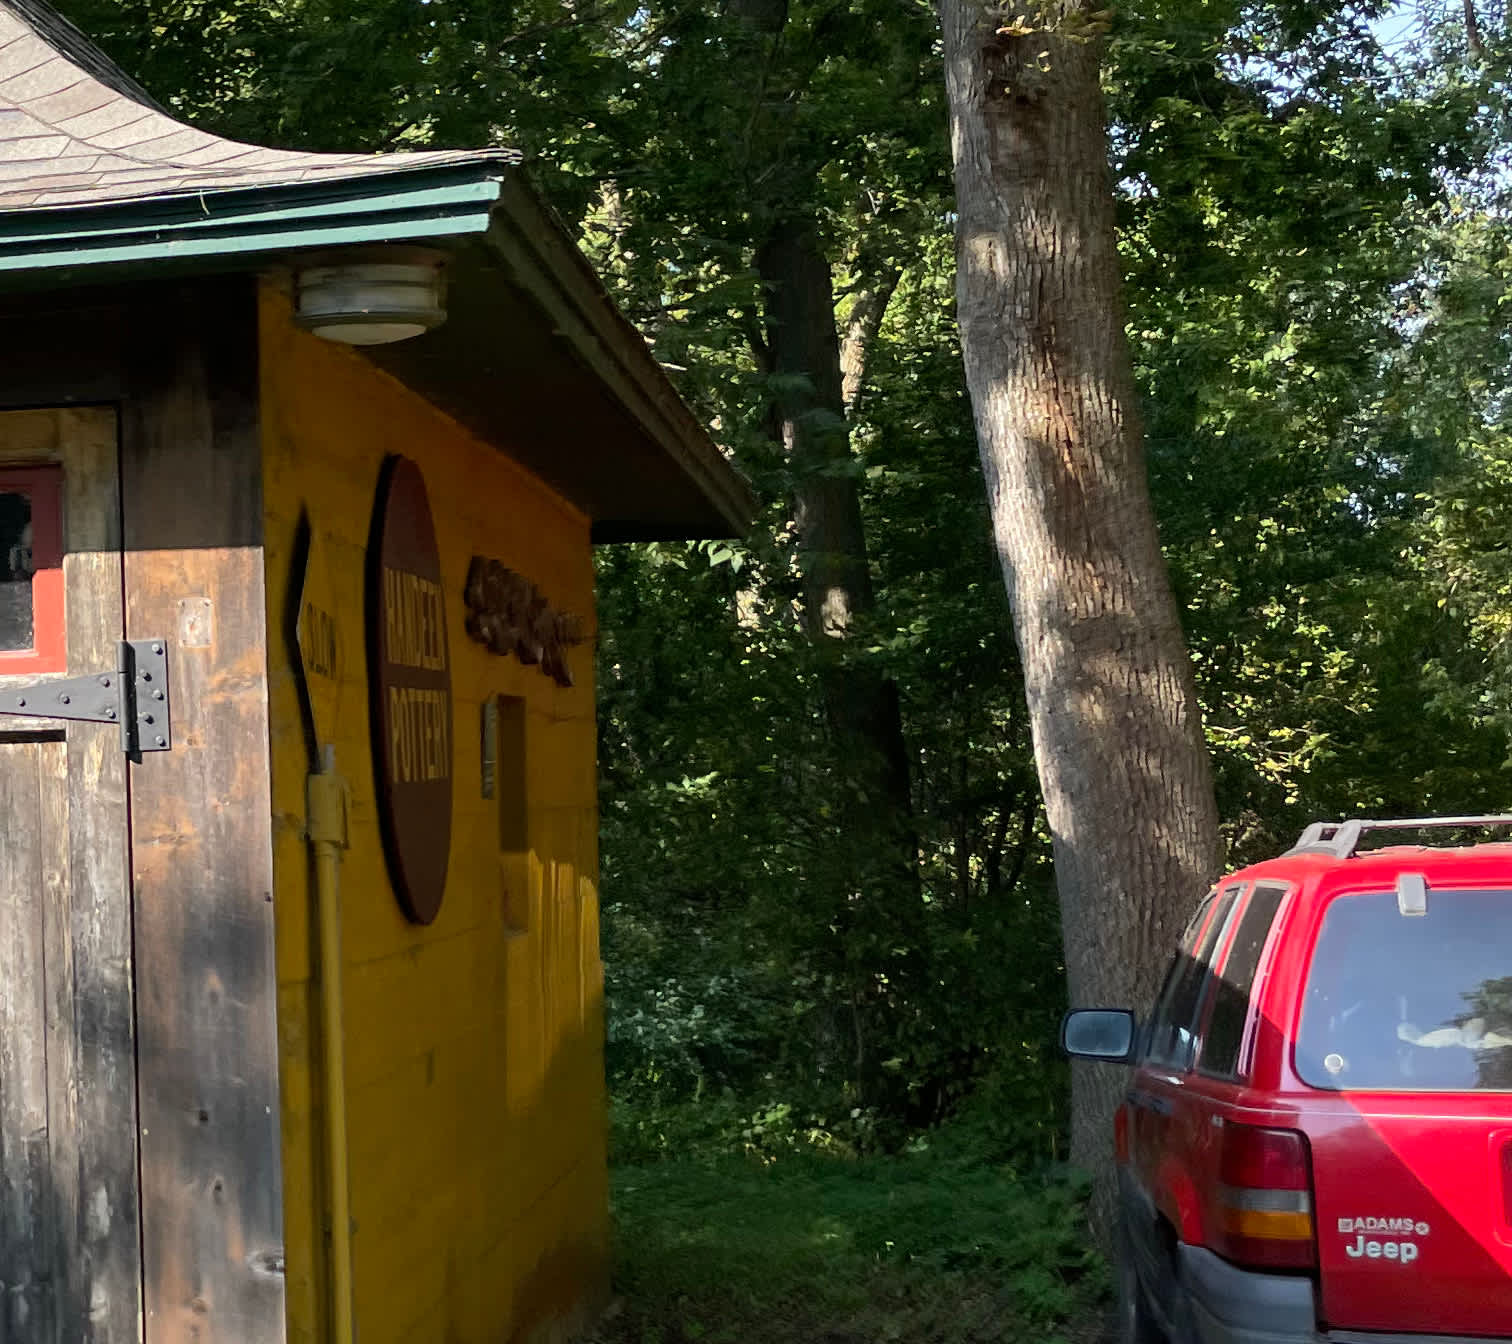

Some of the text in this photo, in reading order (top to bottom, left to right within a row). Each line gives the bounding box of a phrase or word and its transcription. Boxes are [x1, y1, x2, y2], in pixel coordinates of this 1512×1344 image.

[390, 688, 448, 783] POTTERY
[1354, 1217, 1414, 1231] ADAMS
[1346, 1235, 1418, 1263] Jeep
